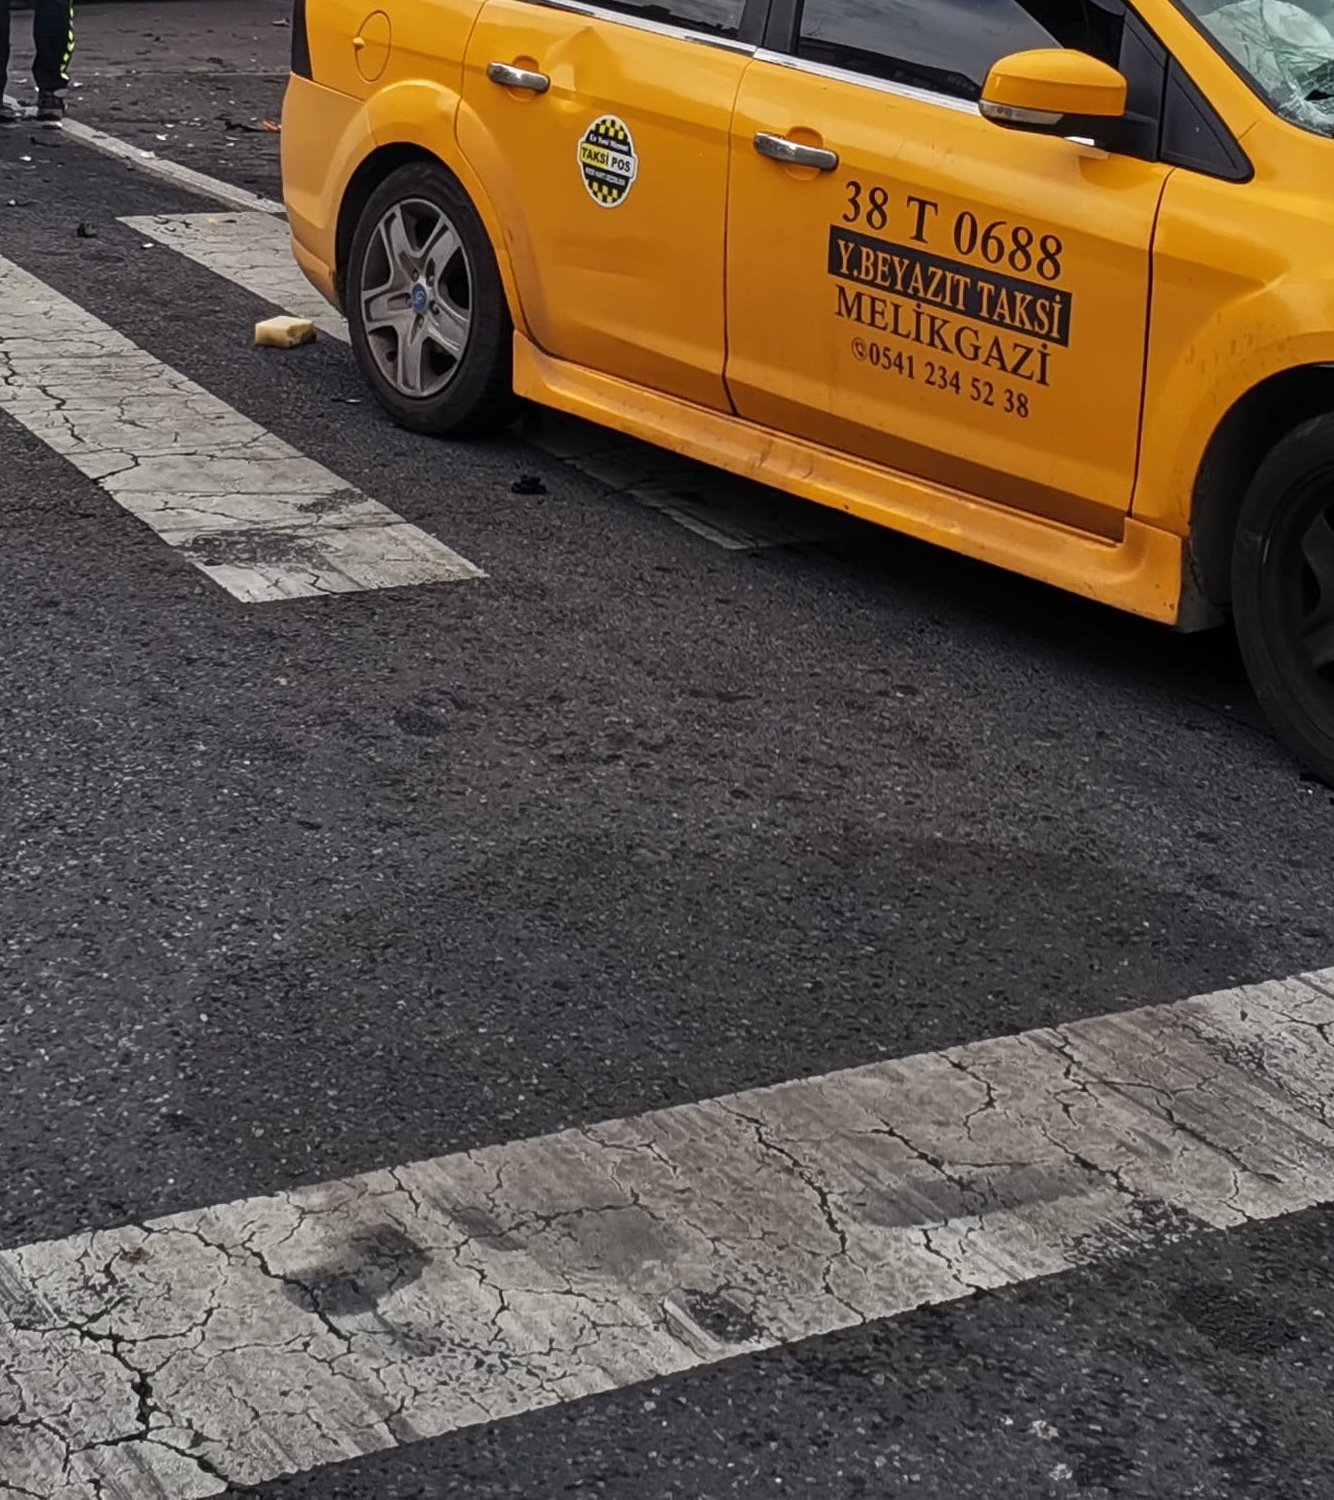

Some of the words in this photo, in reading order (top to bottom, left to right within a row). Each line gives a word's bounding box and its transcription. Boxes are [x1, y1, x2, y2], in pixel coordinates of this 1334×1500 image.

[611, 156, 631, 173] POS
[842, 180, 889, 231] 38
[906, 195, 938, 244] T
[953, 211, 1063, 281] 0688
[834, 283, 1052, 387] MELİKGAZİ
[836, 238, 971, 312] Y.BEYAZIT
[976, 281, 1064, 340] TAKSİ
[868, 342, 916, 380] 0541
[924, 361, 962, 395] 234
[969, 376, 995, 407] 52
[1003, 387, 1030, 419] 38
